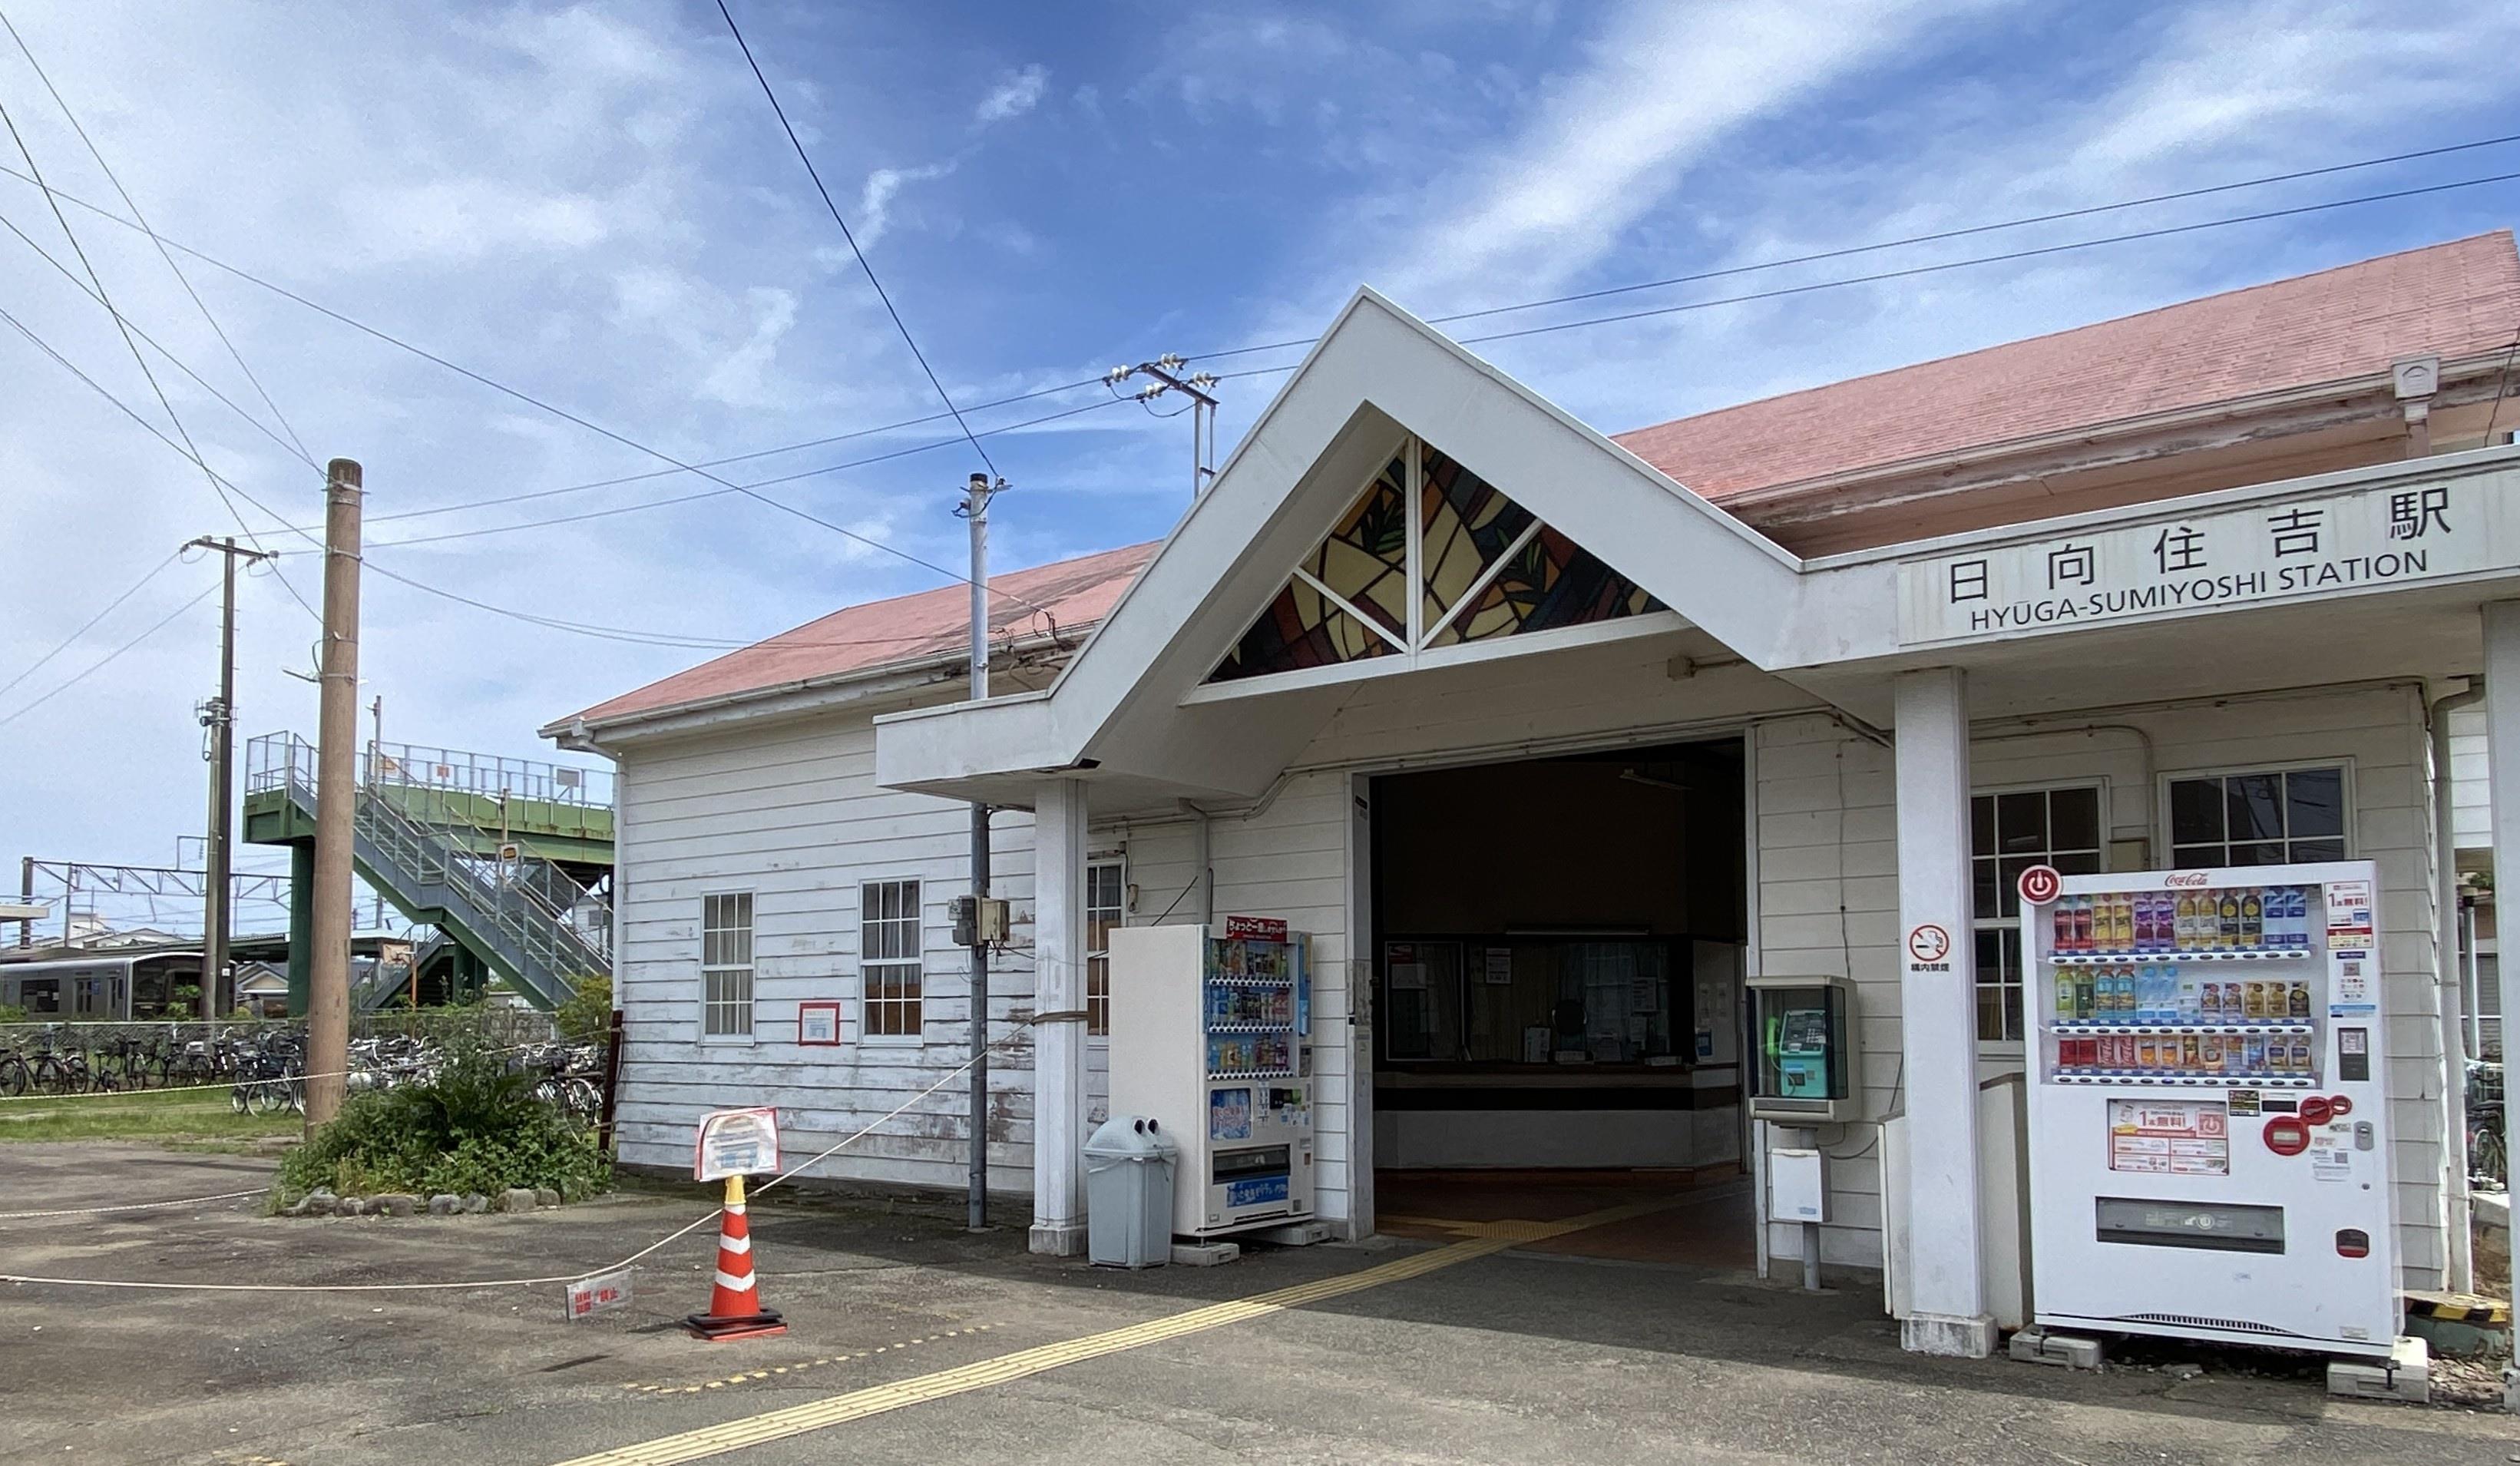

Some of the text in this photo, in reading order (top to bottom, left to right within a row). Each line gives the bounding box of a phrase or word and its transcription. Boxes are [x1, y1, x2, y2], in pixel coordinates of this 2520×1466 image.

[1951, 488, 2451, 604] 日向住吉駅
[2279, 549, 2427, 591] STATION
[2164, 873, 2208, 887] Coca-Cola
